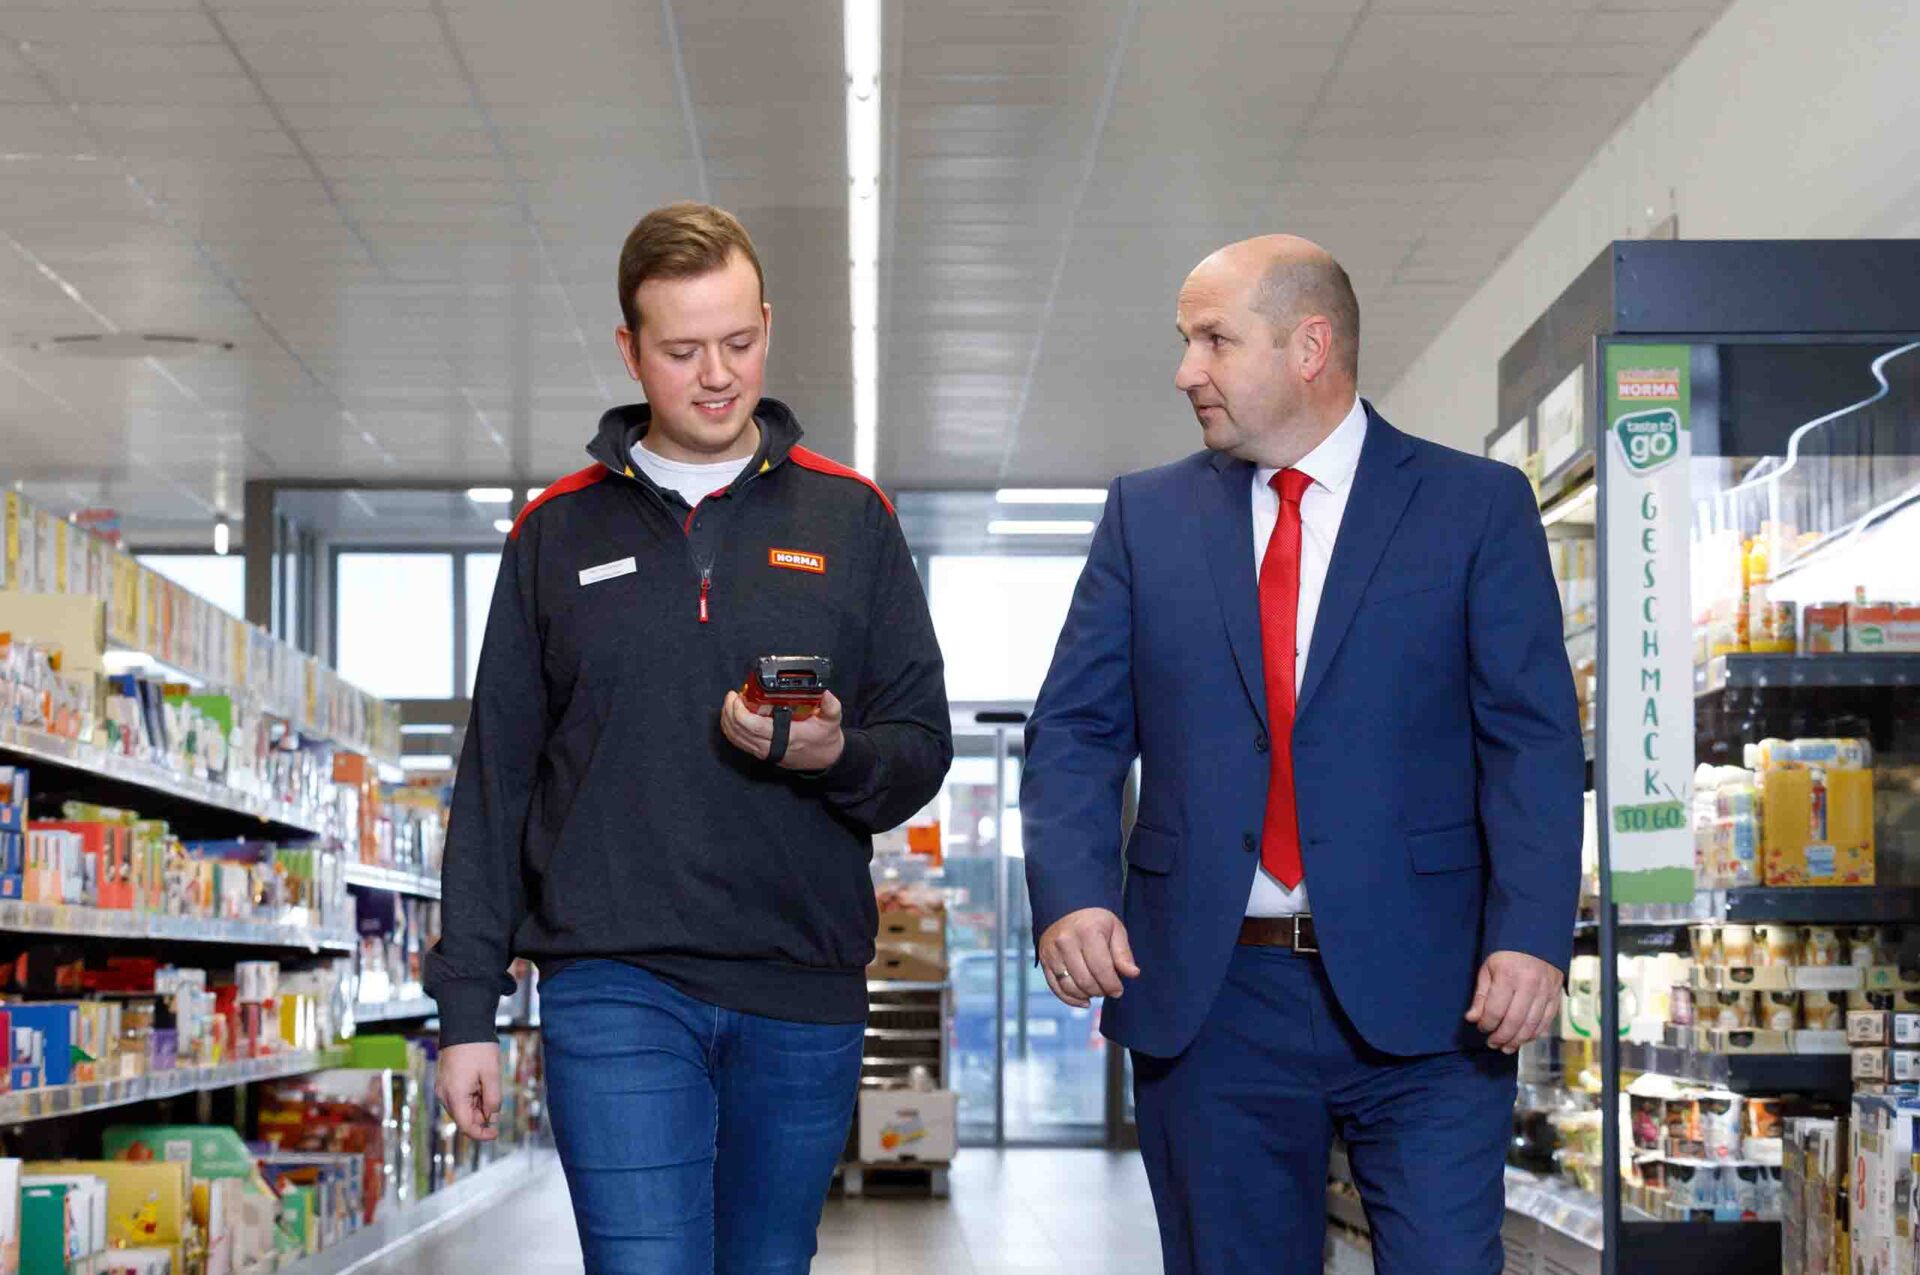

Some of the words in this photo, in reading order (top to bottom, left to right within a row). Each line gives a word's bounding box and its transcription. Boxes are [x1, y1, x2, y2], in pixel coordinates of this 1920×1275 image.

[1619, 383, 1676, 396] NORMA
[1630, 433, 1672, 463] go
[776, 553, 818, 567] NORMA
[1641, 491, 1661, 796] GESCHMACK
[1620, 808, 1648, 829] TO
[1653, 806, 1680, 829] GO
